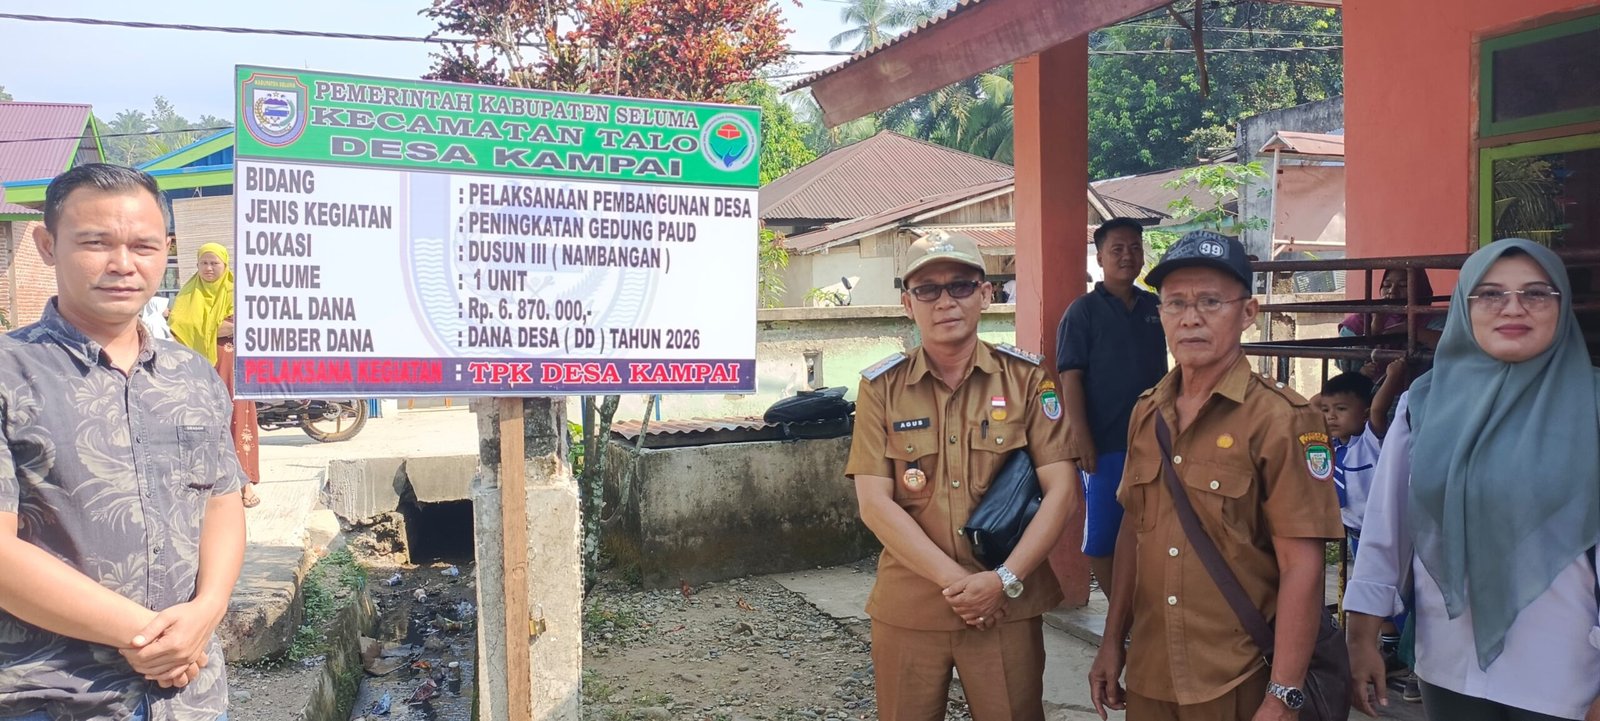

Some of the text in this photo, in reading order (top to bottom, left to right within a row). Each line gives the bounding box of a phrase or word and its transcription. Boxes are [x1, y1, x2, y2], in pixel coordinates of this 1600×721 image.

[315, 81, 699, 129] PEMERINTAH KABUPATEN SELUMA
[311, 107, 584, 145] KECAMATAN
[597, 130, 698, 152] TALO
[331, 136, 681, 177] DESA KAMPAI
[246, 167, 314, 194] BIDANG
[469, 184, 587, 210] PELAKSANAAN
[594, 191, 709, 216] PEMBANGUNAN
[715, 197, 751, 218] DESA
[245, 199, 298, 225] JENIS
[305, 202, 392, 228] KEGIATAN
[469, 212, 584, 238] PENINGKATAN
[589, 220, 652, 241] GEDUNG
[658, 221, 696, 242] PAUD
[246, 231, 311, 257] LOKASI
[469, 241, 525, 263] DUSUN
[532, 244, 546, 264] III
[562, 245, 661, 268] NAMBANGAN
[245, 263, 320, 289] VULUME
[474, 269, 480, 290] 1
[488, 269, 527, 291] UNIT
[245, 295, 302, 320] TOTAL
[309, 297, 356, 321] DANA
[469, 298, 493, 323] Rp.
[499, 298, 512, 320] 6.
[518, 299, 549, 320] 870.
[555, 300, 592, 324] 000,-
[245, 327, 321, 352] SUMBER
[327, 329, 373, 352] DANA
[468, 326, 512, 347] DANA
[518, 327, 559, 348] DESA
[575, 328, 595, 348] DD
[610, 329, 661, 349] TAHUN
[666, 329, 700, 349] 2026
[245, 360, 352, 383] PELAKSANA
[358, 361, 443, 383] KEGIATAN
[468, 362, 532, 383] TPK
[541, 363, 620, 384] DESA
[630, 363, 739, 383] KAMPAI
